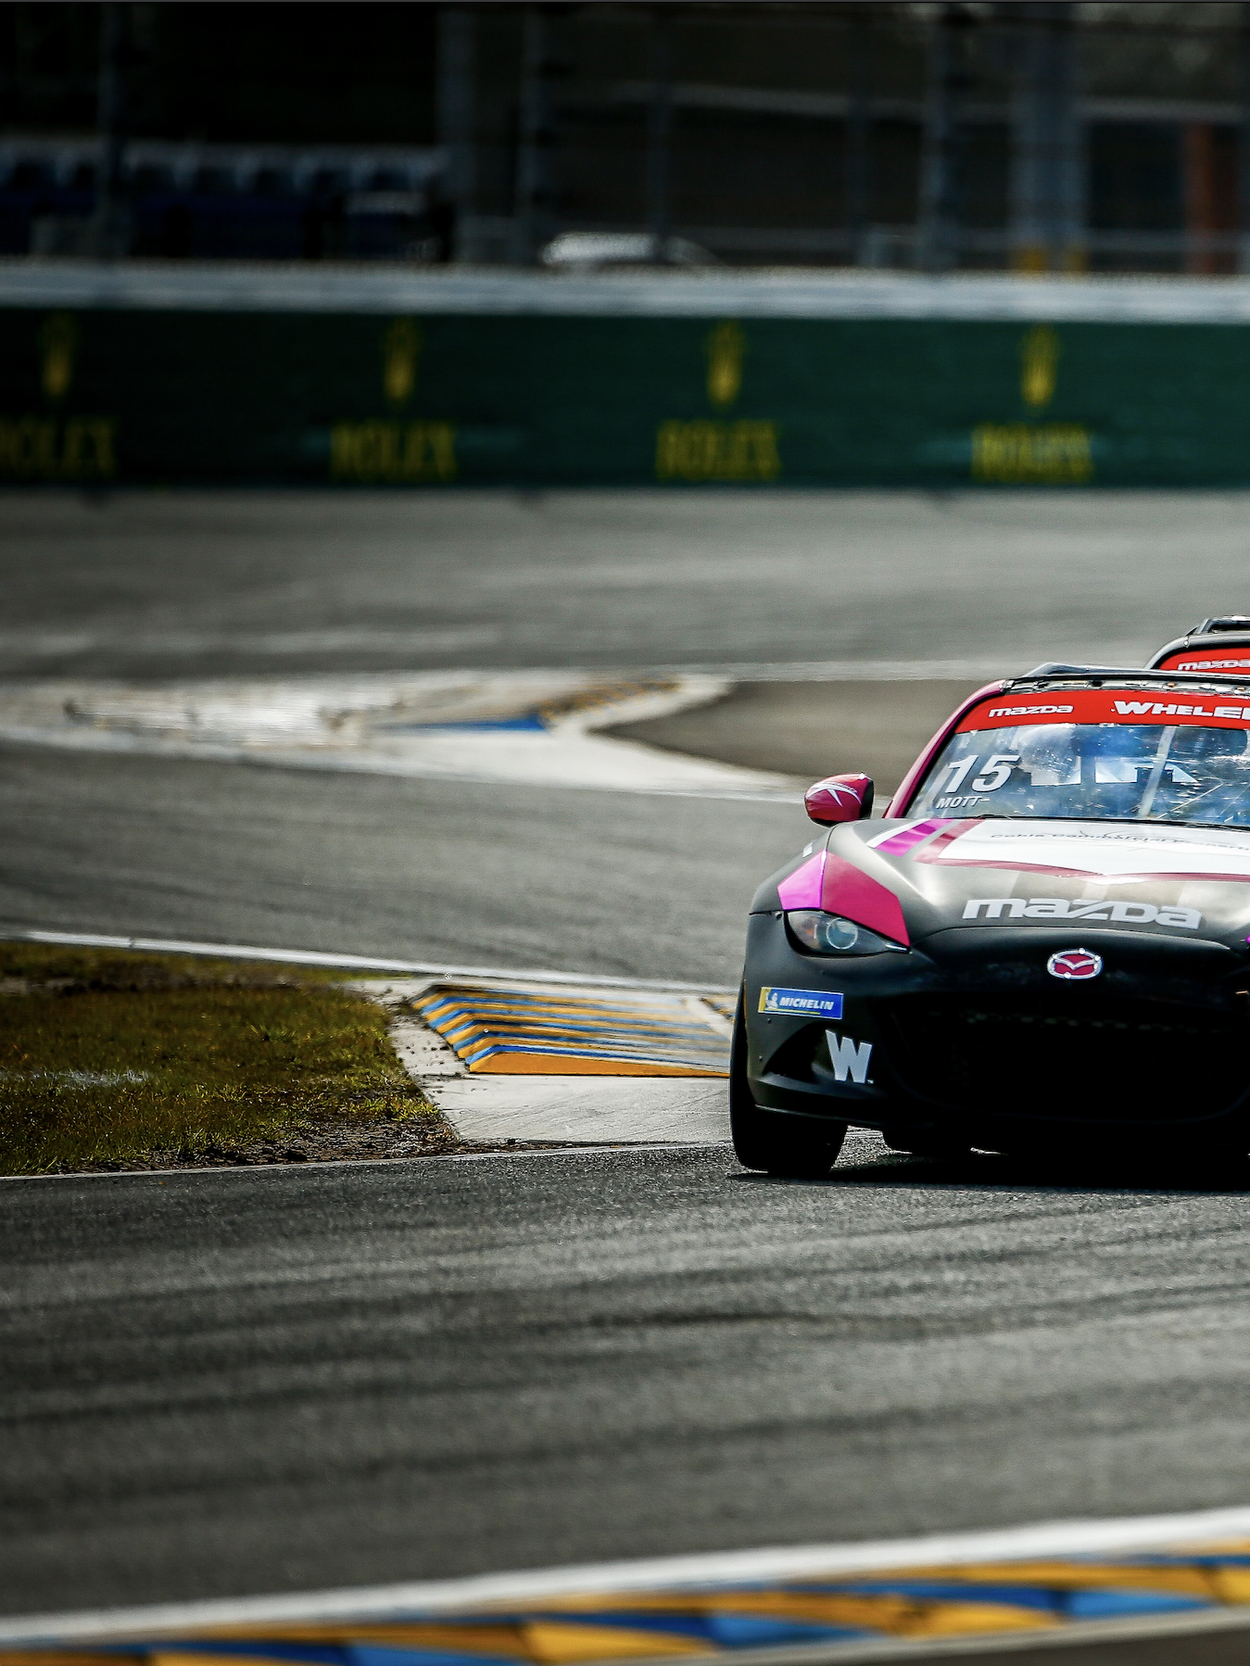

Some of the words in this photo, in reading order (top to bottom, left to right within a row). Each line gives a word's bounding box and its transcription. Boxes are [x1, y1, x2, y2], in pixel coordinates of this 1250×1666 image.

[988, 705, 1074, 717] mazda
[945, 754, 1021, 793] 15
[936, 796, 982, 808] MOTT
[962, 898, 1202, 930] mazda
[779, 997, 834, 1010] MICHELIN
[825, 1029, 872, 1084] W
